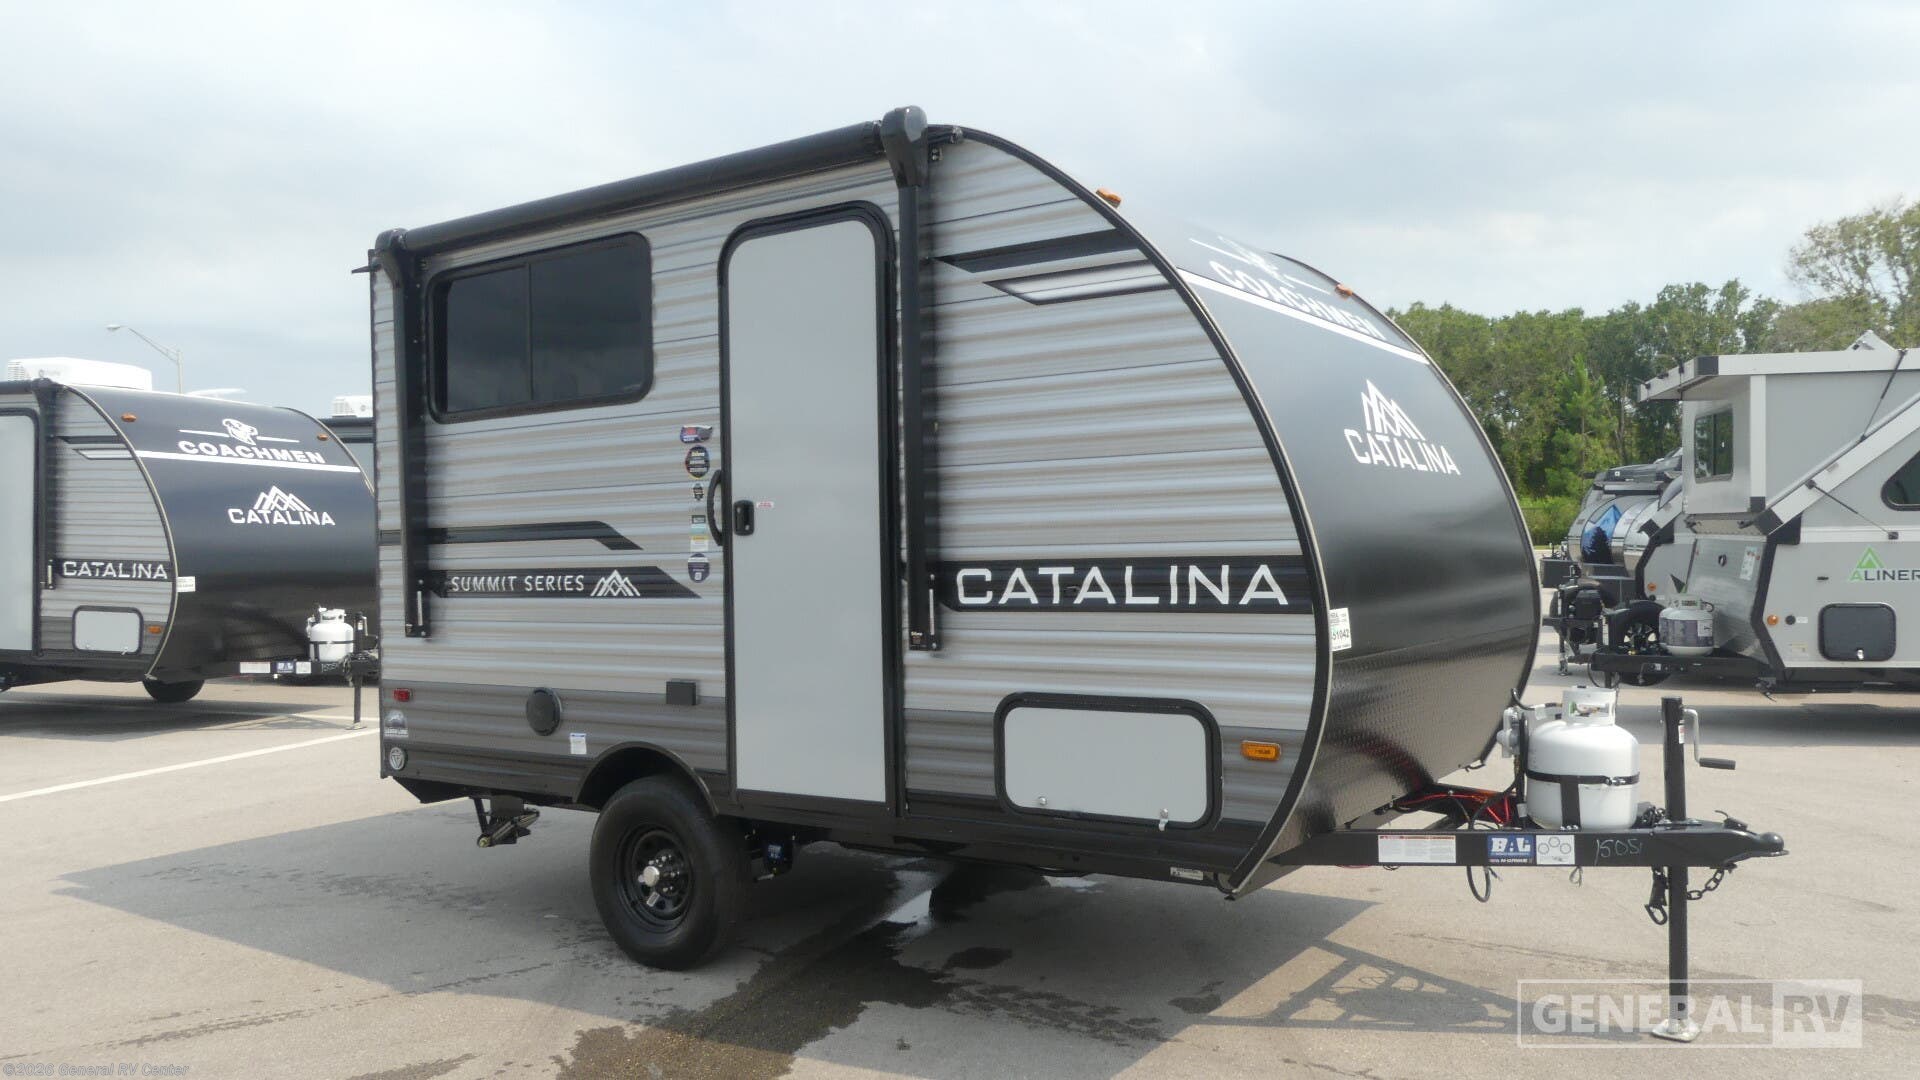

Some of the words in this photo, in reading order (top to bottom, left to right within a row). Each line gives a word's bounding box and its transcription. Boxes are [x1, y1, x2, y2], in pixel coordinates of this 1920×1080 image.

[1208, 260, 1387, 341] COACHMEN
[178, 440, 326, 464] COACHMEN
[1343, 428, 1461, 475] CATALINA
[228, 507, 336, 526] CATALINA
[62, 561, 168, 580] CATALINA
[1850, 569, 1920, 581] ALINER
[450, 575, 517, 592] SUMMIT
[524, 574, 585, 592] SERIES
[956, 564, 1289, 606] CATALINA
[1491, 837, 1531, 852] BAL
